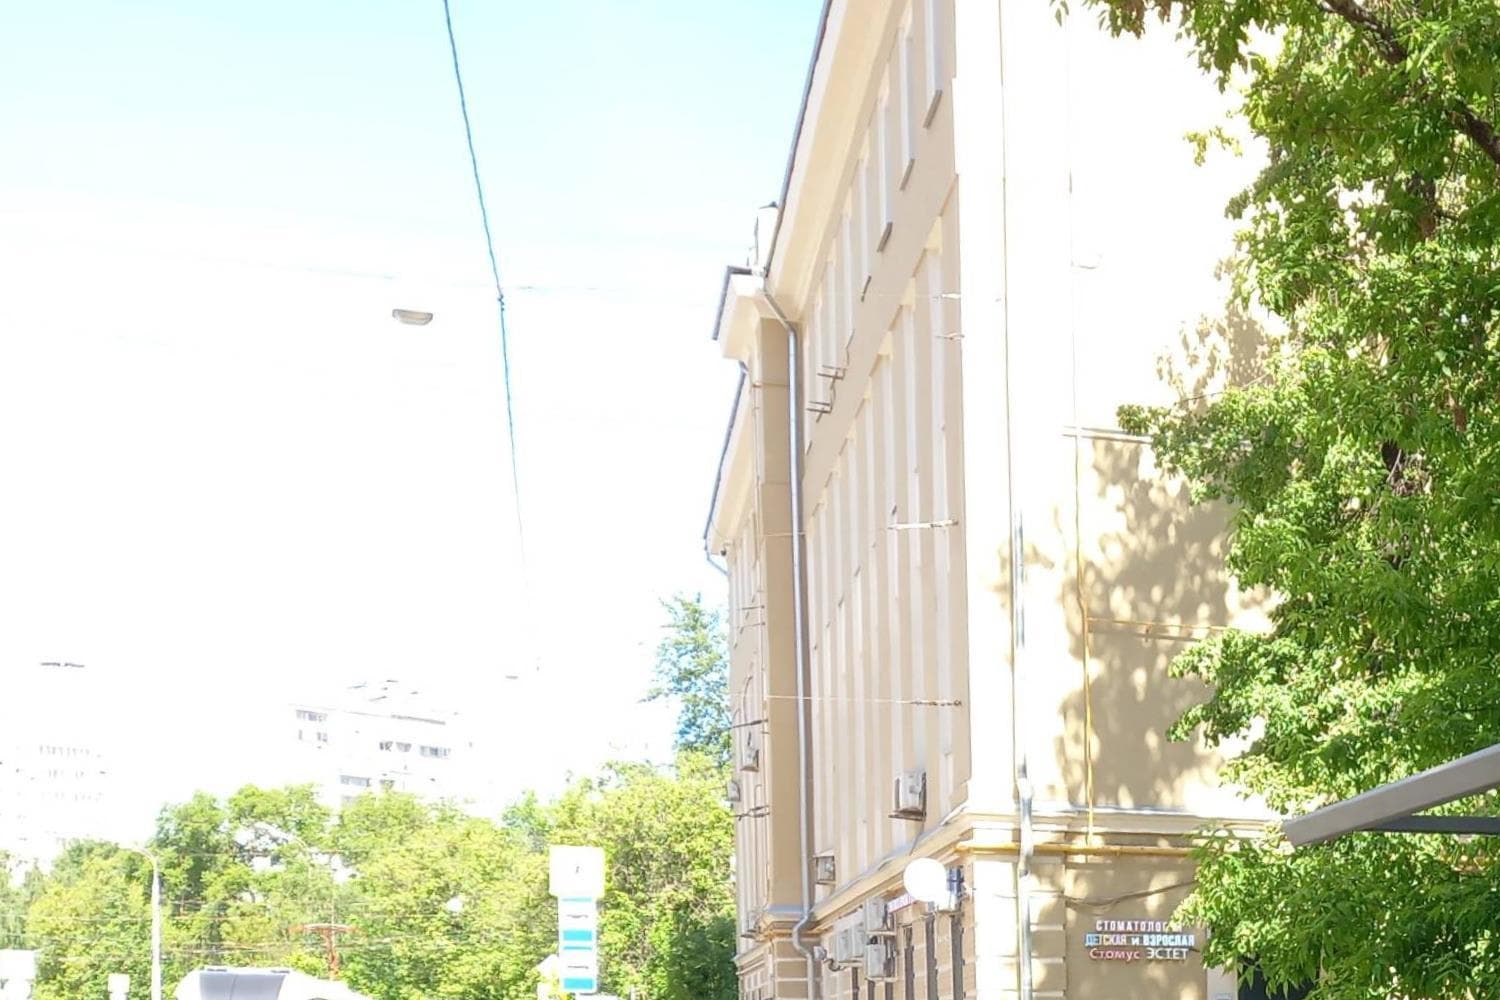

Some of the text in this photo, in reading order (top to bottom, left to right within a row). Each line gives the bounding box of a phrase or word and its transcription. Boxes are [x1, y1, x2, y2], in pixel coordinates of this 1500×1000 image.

[1086, 934, 1126, 946] ДЕТСКАЯ
[1143, 935, 1195, 946] ВЗРОСЛАЯ
[1089, 948, 1189, 961] Стомус ЭСТЕТ
